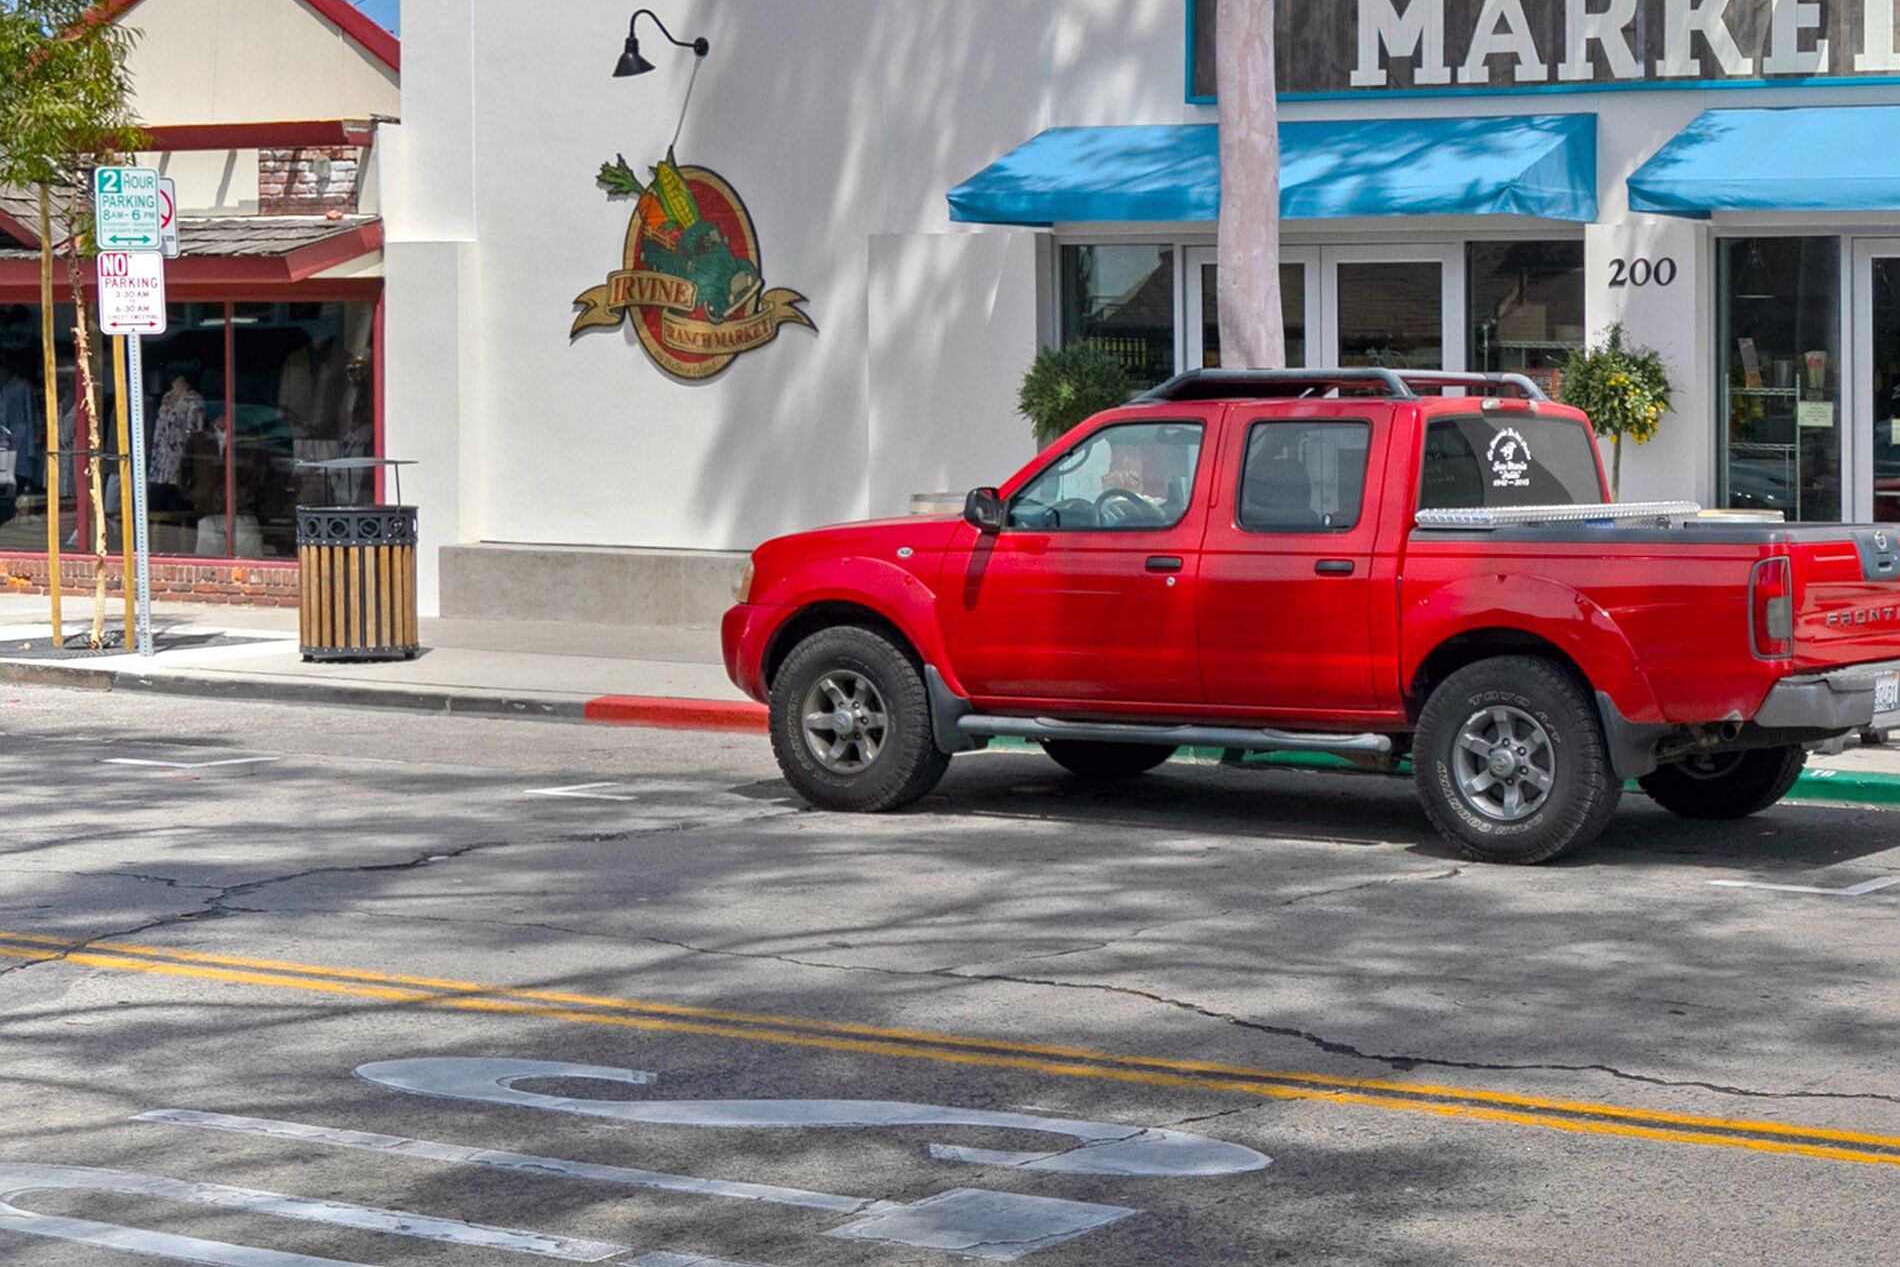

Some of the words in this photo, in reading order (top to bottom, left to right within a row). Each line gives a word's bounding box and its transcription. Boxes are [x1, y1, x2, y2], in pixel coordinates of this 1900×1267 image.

[103, 171, 119, 192] 2
[123, 175, 154, 189] HOUR
[102, 195, 155, 208] PARKING
[102, 254, 127, 276] NO
[1608, 258, 1677, 289] 200
[104, 277, 158, 289] PARKING
[610, 276, 690, 305] IRVINE
[667, 325, 716, 348] RANCH
[717, 319, 769, 349] MARKET
[1468, 690, 1530, 708] TOYO
